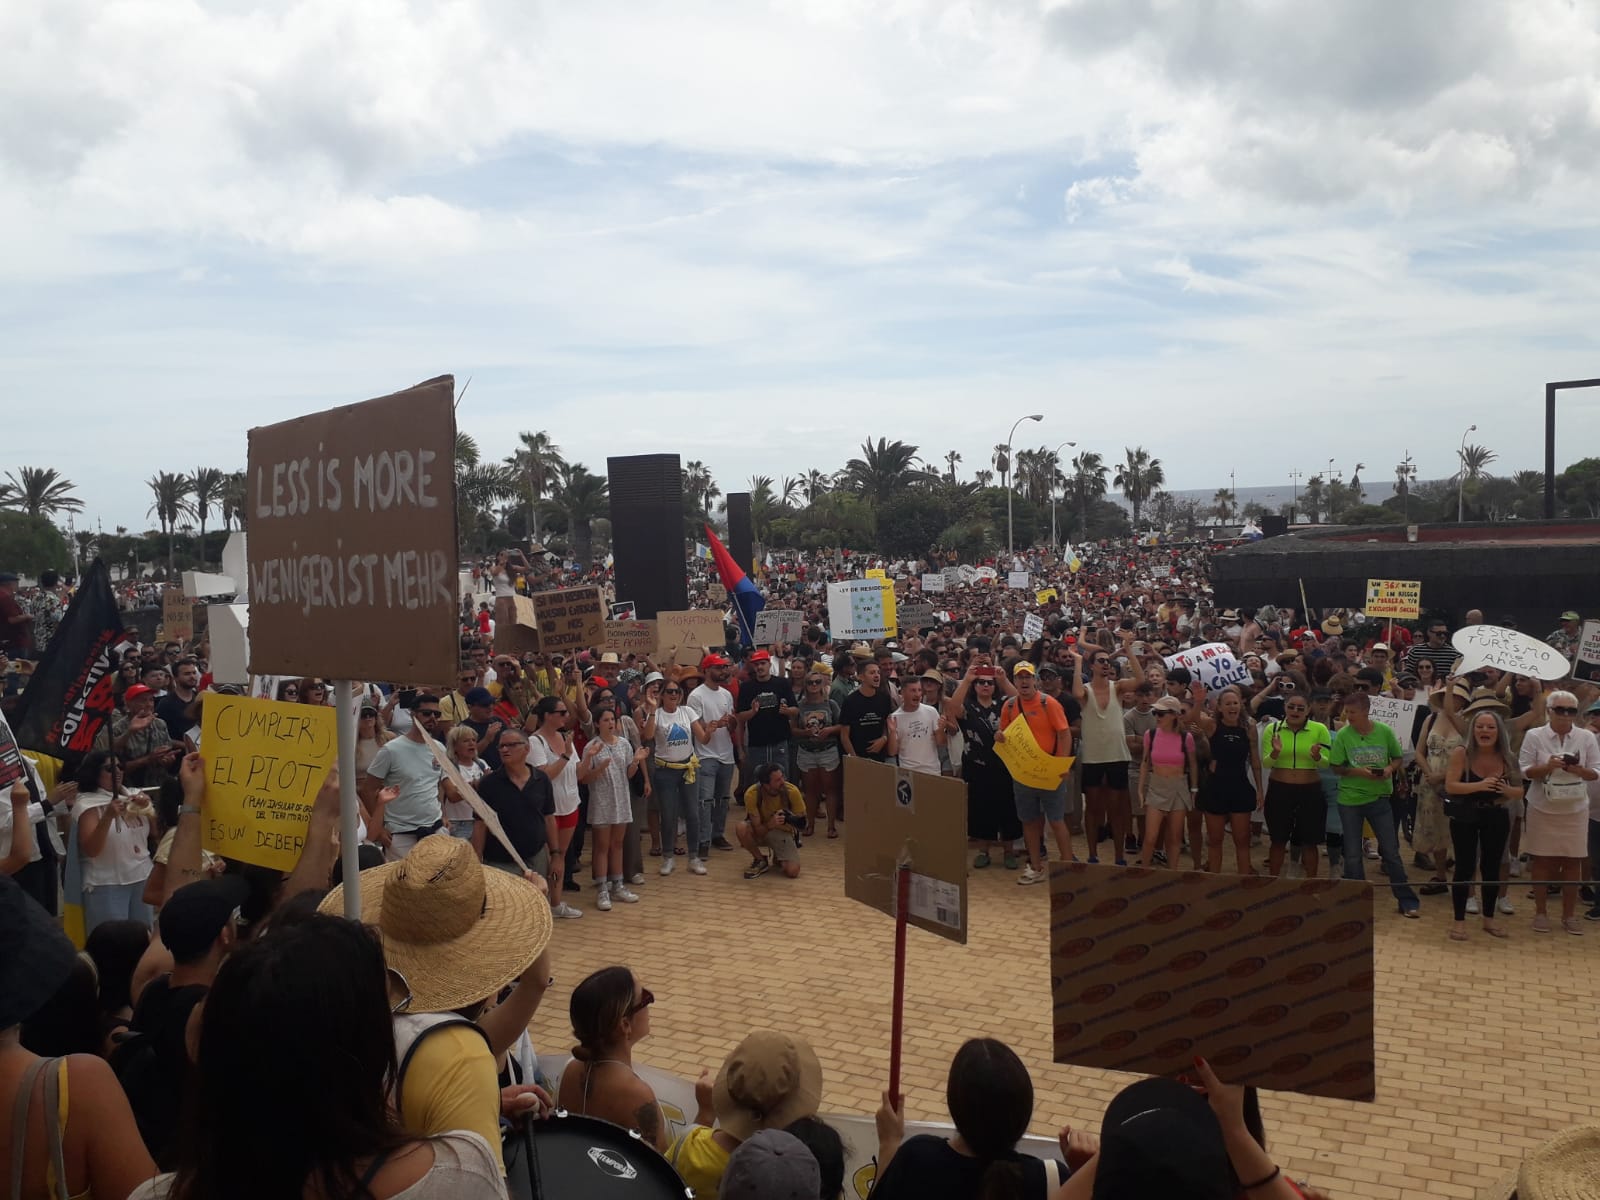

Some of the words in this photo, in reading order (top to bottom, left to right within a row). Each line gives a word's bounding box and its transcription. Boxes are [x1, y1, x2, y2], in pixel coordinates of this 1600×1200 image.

[256, 457, 311, 518] LESS
[354, 447, 438, 512] MORE
[382, 550, 452, 610] MEHR
[1384, 581, 1400, 589] 36%
[667, 615, 721, 625] MORATORIA
[606, 639, 620, 649] SE
[1201, 648, 1216, 660] MI
[1209, 658, 1231, 673] YO
[61, 645, 110, 747] COLECTIV
[1389, 701, 1400, 710] DE
[1403, 702, 1413, 712] LA
[216, 704, 314, 744] CUMPLIR
[212, 756, 239, 785] EL
[246, 755, 322, 797] PIOT
[228, 826, 245, 840] UN
[254, 831, 305, 856] DEBER
